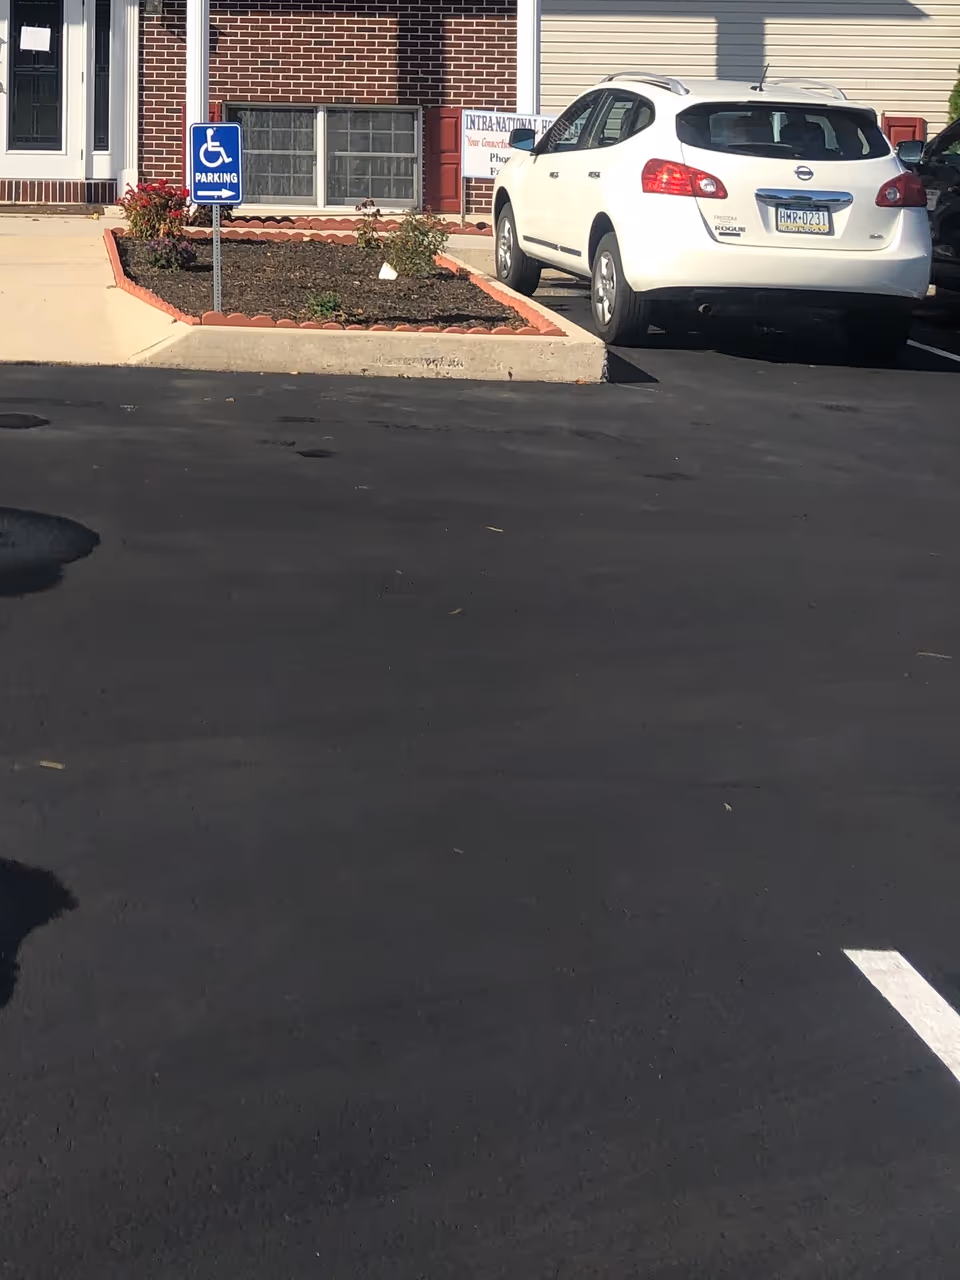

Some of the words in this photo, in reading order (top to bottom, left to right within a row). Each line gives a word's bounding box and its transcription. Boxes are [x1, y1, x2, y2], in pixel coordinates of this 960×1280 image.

[466, 114, 539, 133] INTRA-NATIONAL
[195, 172, 238, 184] PARKING
[714, 225, 746, 233] ROGUE
